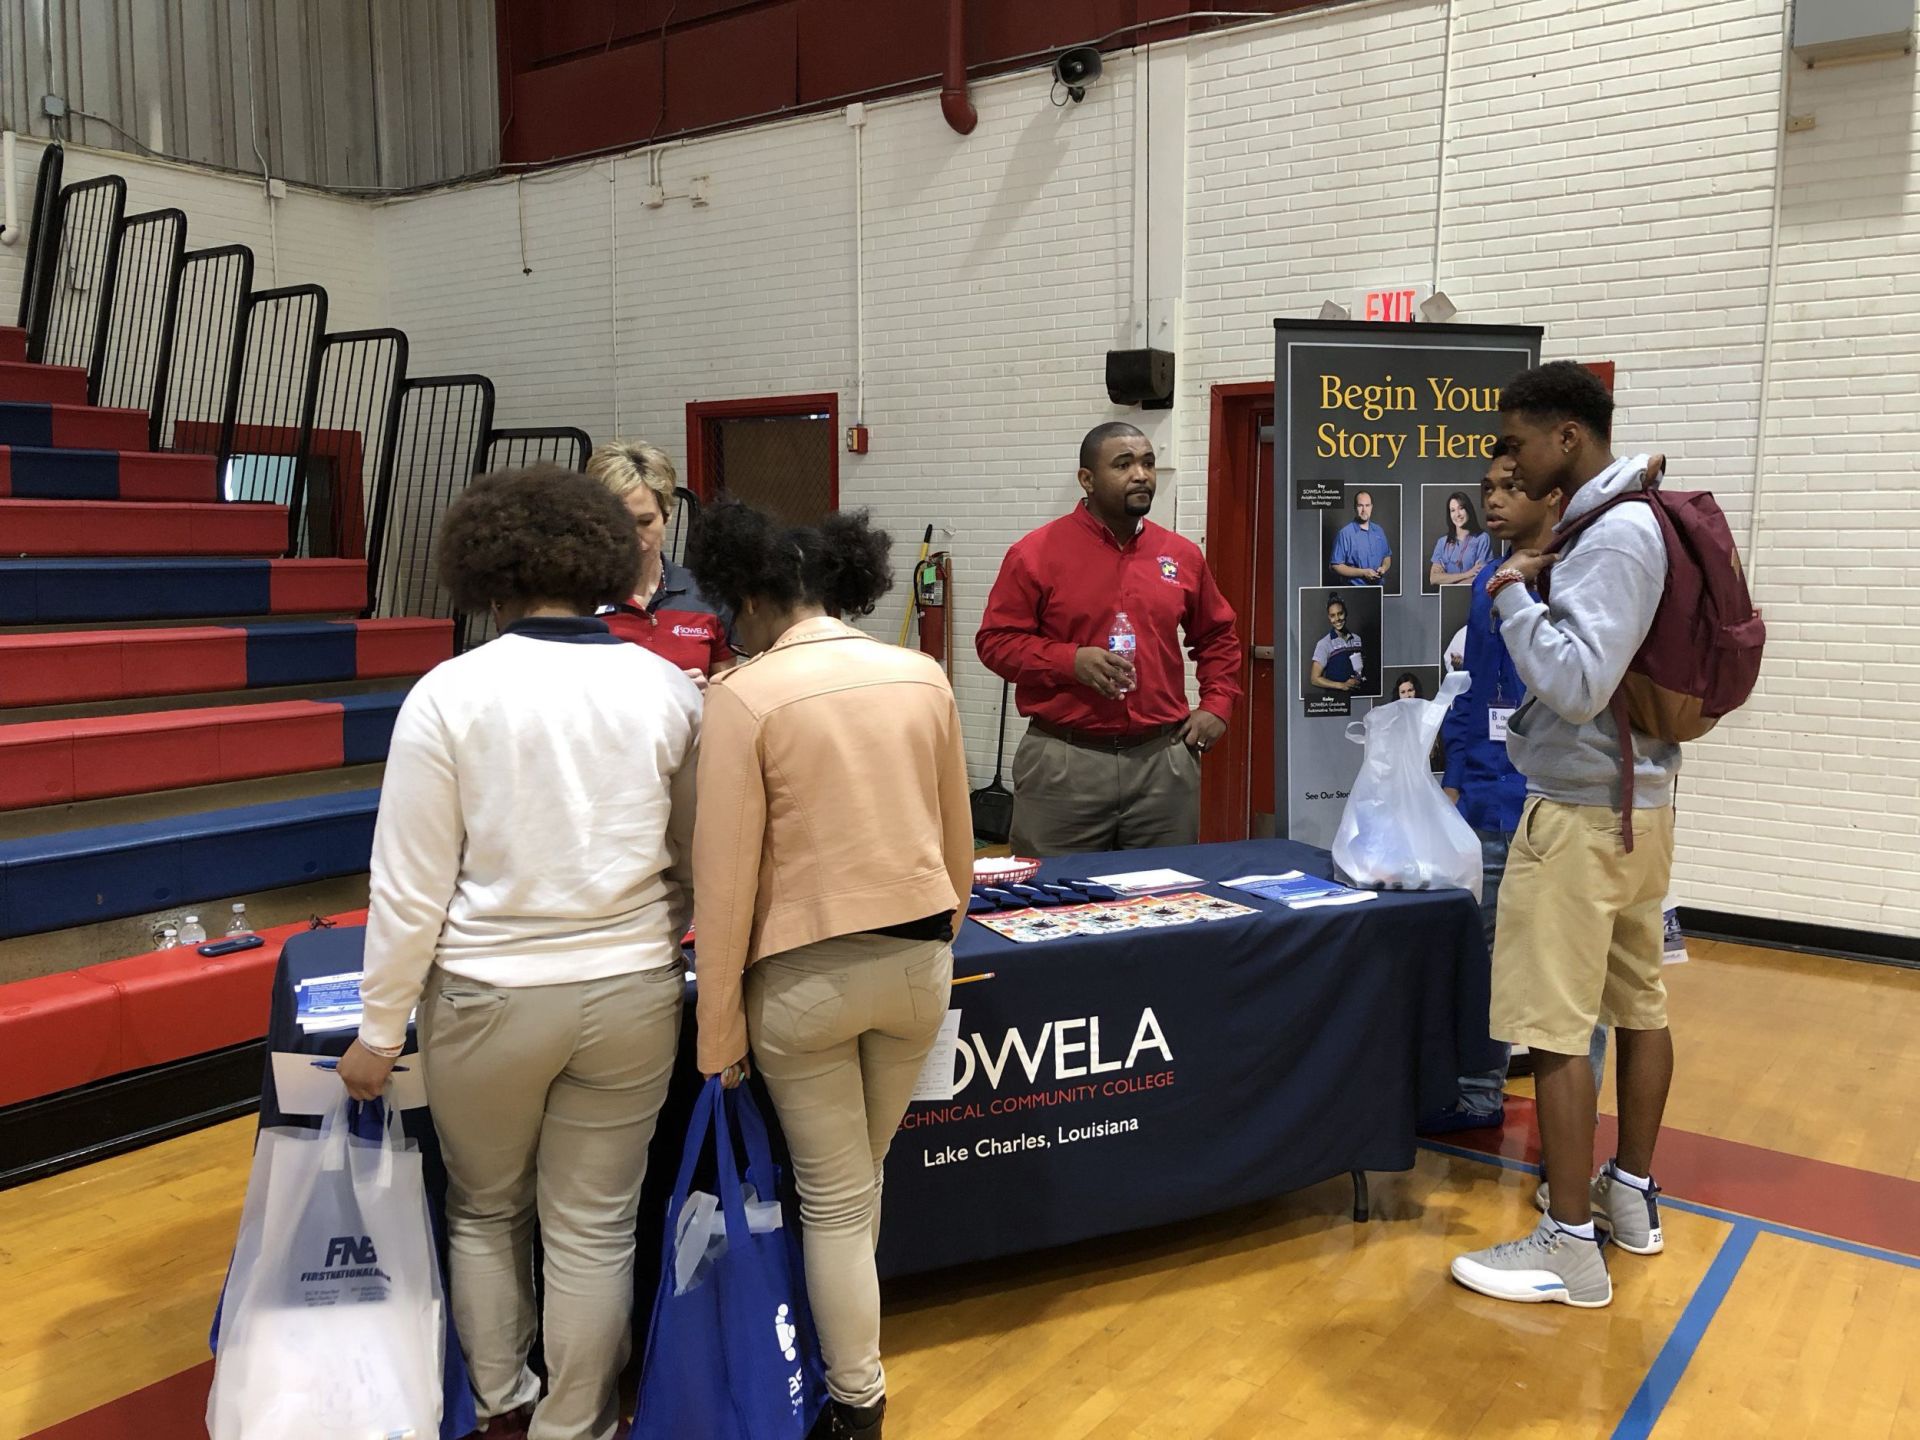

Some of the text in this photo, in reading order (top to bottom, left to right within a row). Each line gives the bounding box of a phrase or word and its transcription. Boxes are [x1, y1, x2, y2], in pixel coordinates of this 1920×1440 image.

[1366, 291, 1416, 322] EXIT
[1319, 375, 1418, 421] Begin
[1316, 422, 1498, 469] Story Here
[679, 626, 709, 635] SOWELA
[1305, 791, 1319, 800] See
[1320, 791, 1334, 800] Our
[989, 1084, 1099, 1115] COMMUNITY
[1102, 1071, 1175, 1097] COLLEGE
[923, 1116, 1139, 1168] Lake Charles, Louisiana
[325, 1236, 378, 1268] FNB
